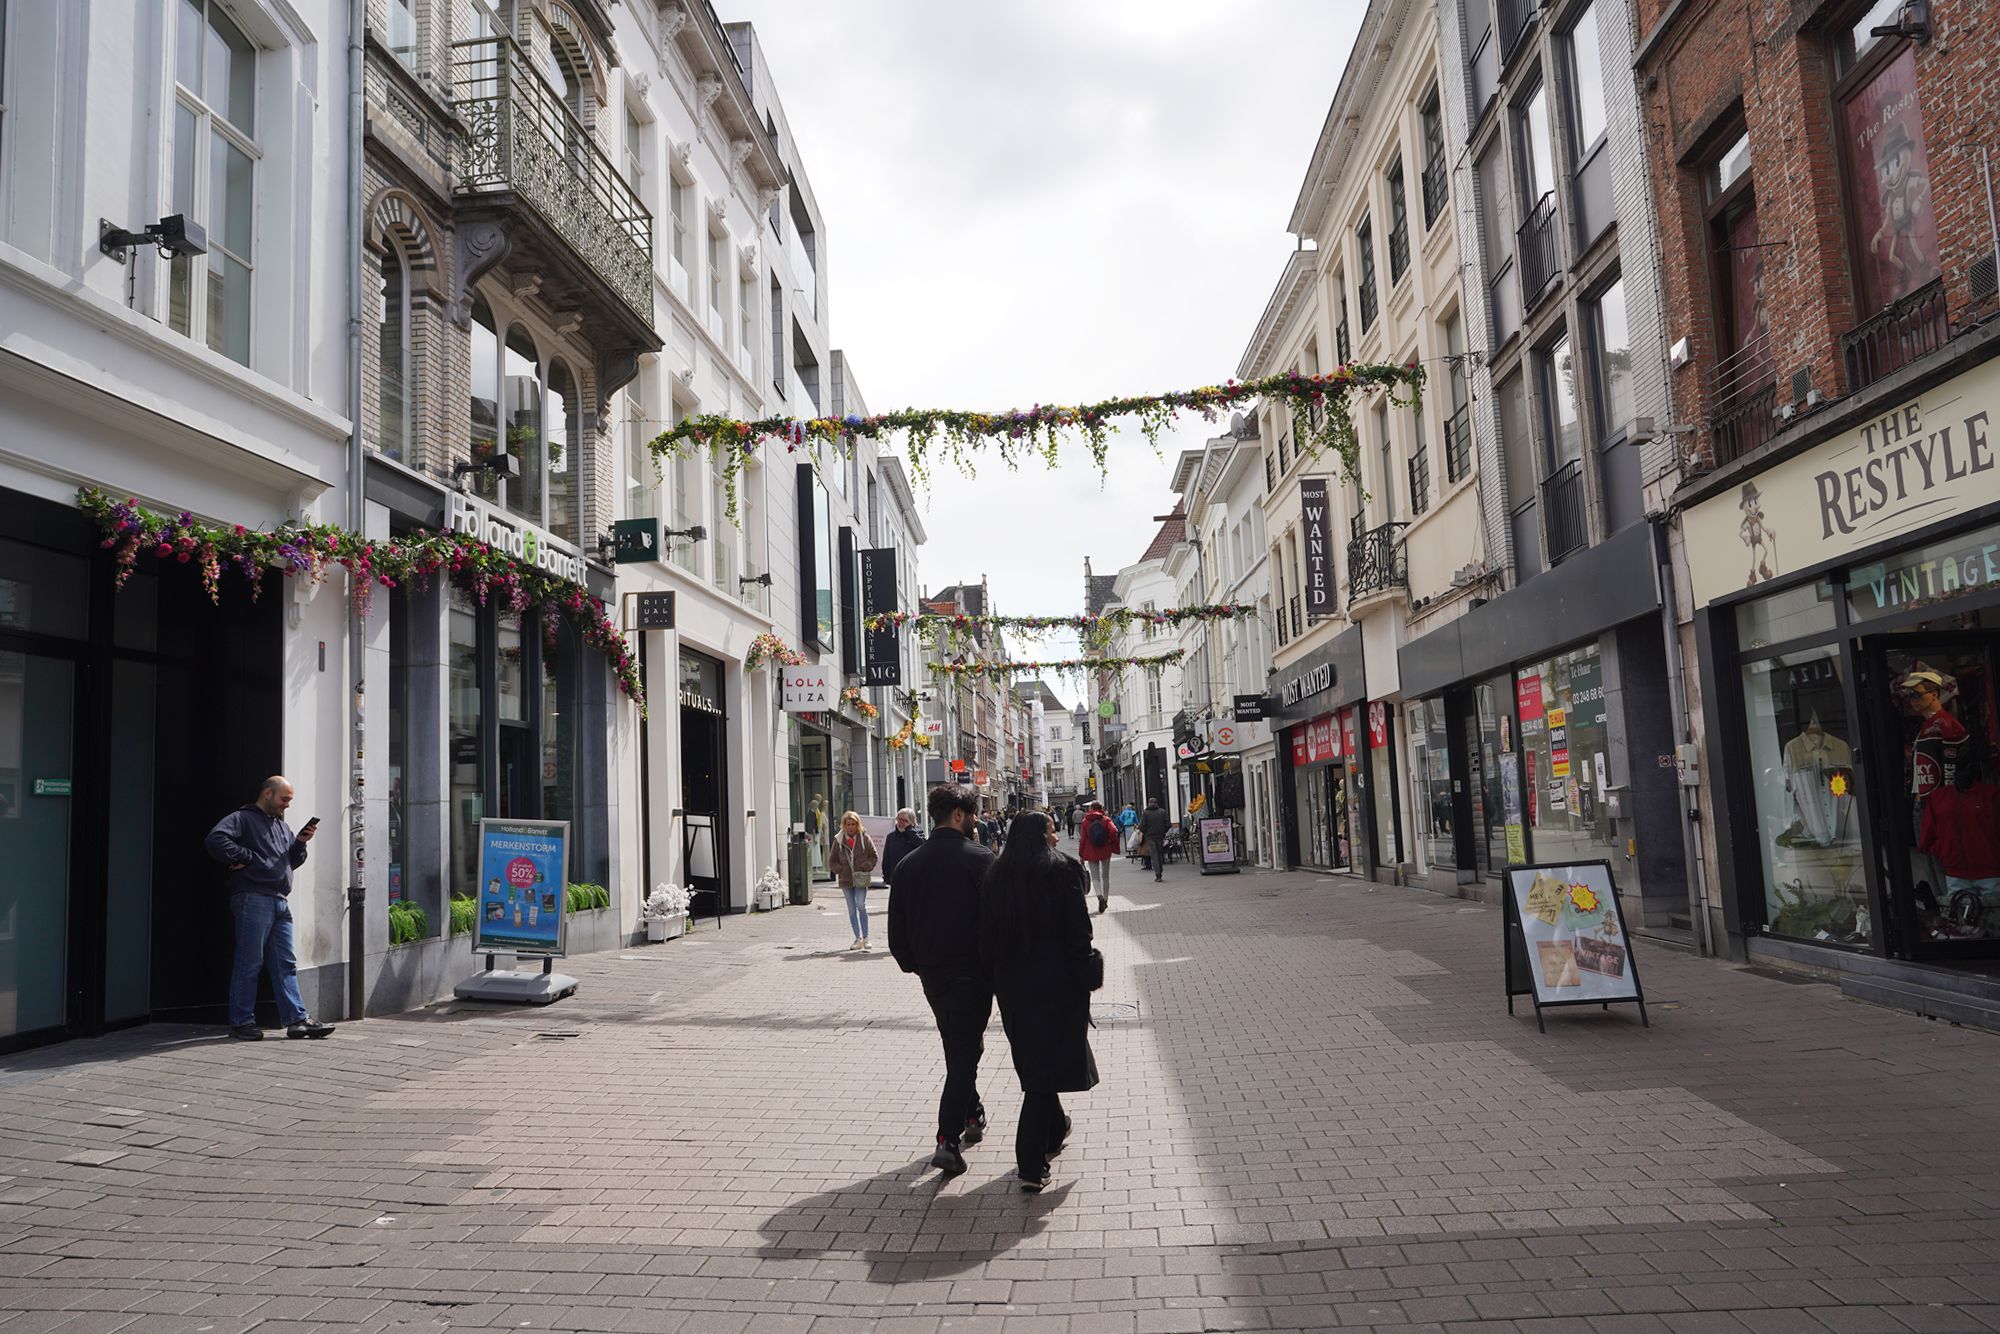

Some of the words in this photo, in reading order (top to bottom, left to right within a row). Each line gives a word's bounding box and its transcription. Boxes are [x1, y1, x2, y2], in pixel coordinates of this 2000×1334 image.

[1857, 121, 1880, 150] The
[1882, 88, 1919, 126] Resty
[1860, 402, 1923, 455] THE
[1302, 490, 1325, 499] MOST
[1814, 410, 1995, 541] RESTYLE
[445, 490, 523, 560] Holland
[536, 534, 588, 589] Barrett
[1305, 506, 1326, 605] WANTED
[866, 556, 874, 613] SHOPPING
[786, 678, 825, 687] LOLA
[786, 693, 825, 702] LIZA
[1281, 678, 1299, 708] MOST
[1299, 662, 1331, 699] WANTED
[490, 840, 557, 852] MERKENSTORM
[500, 826, 524, 834] Holland
[511, 867, 534, 879] 50%
